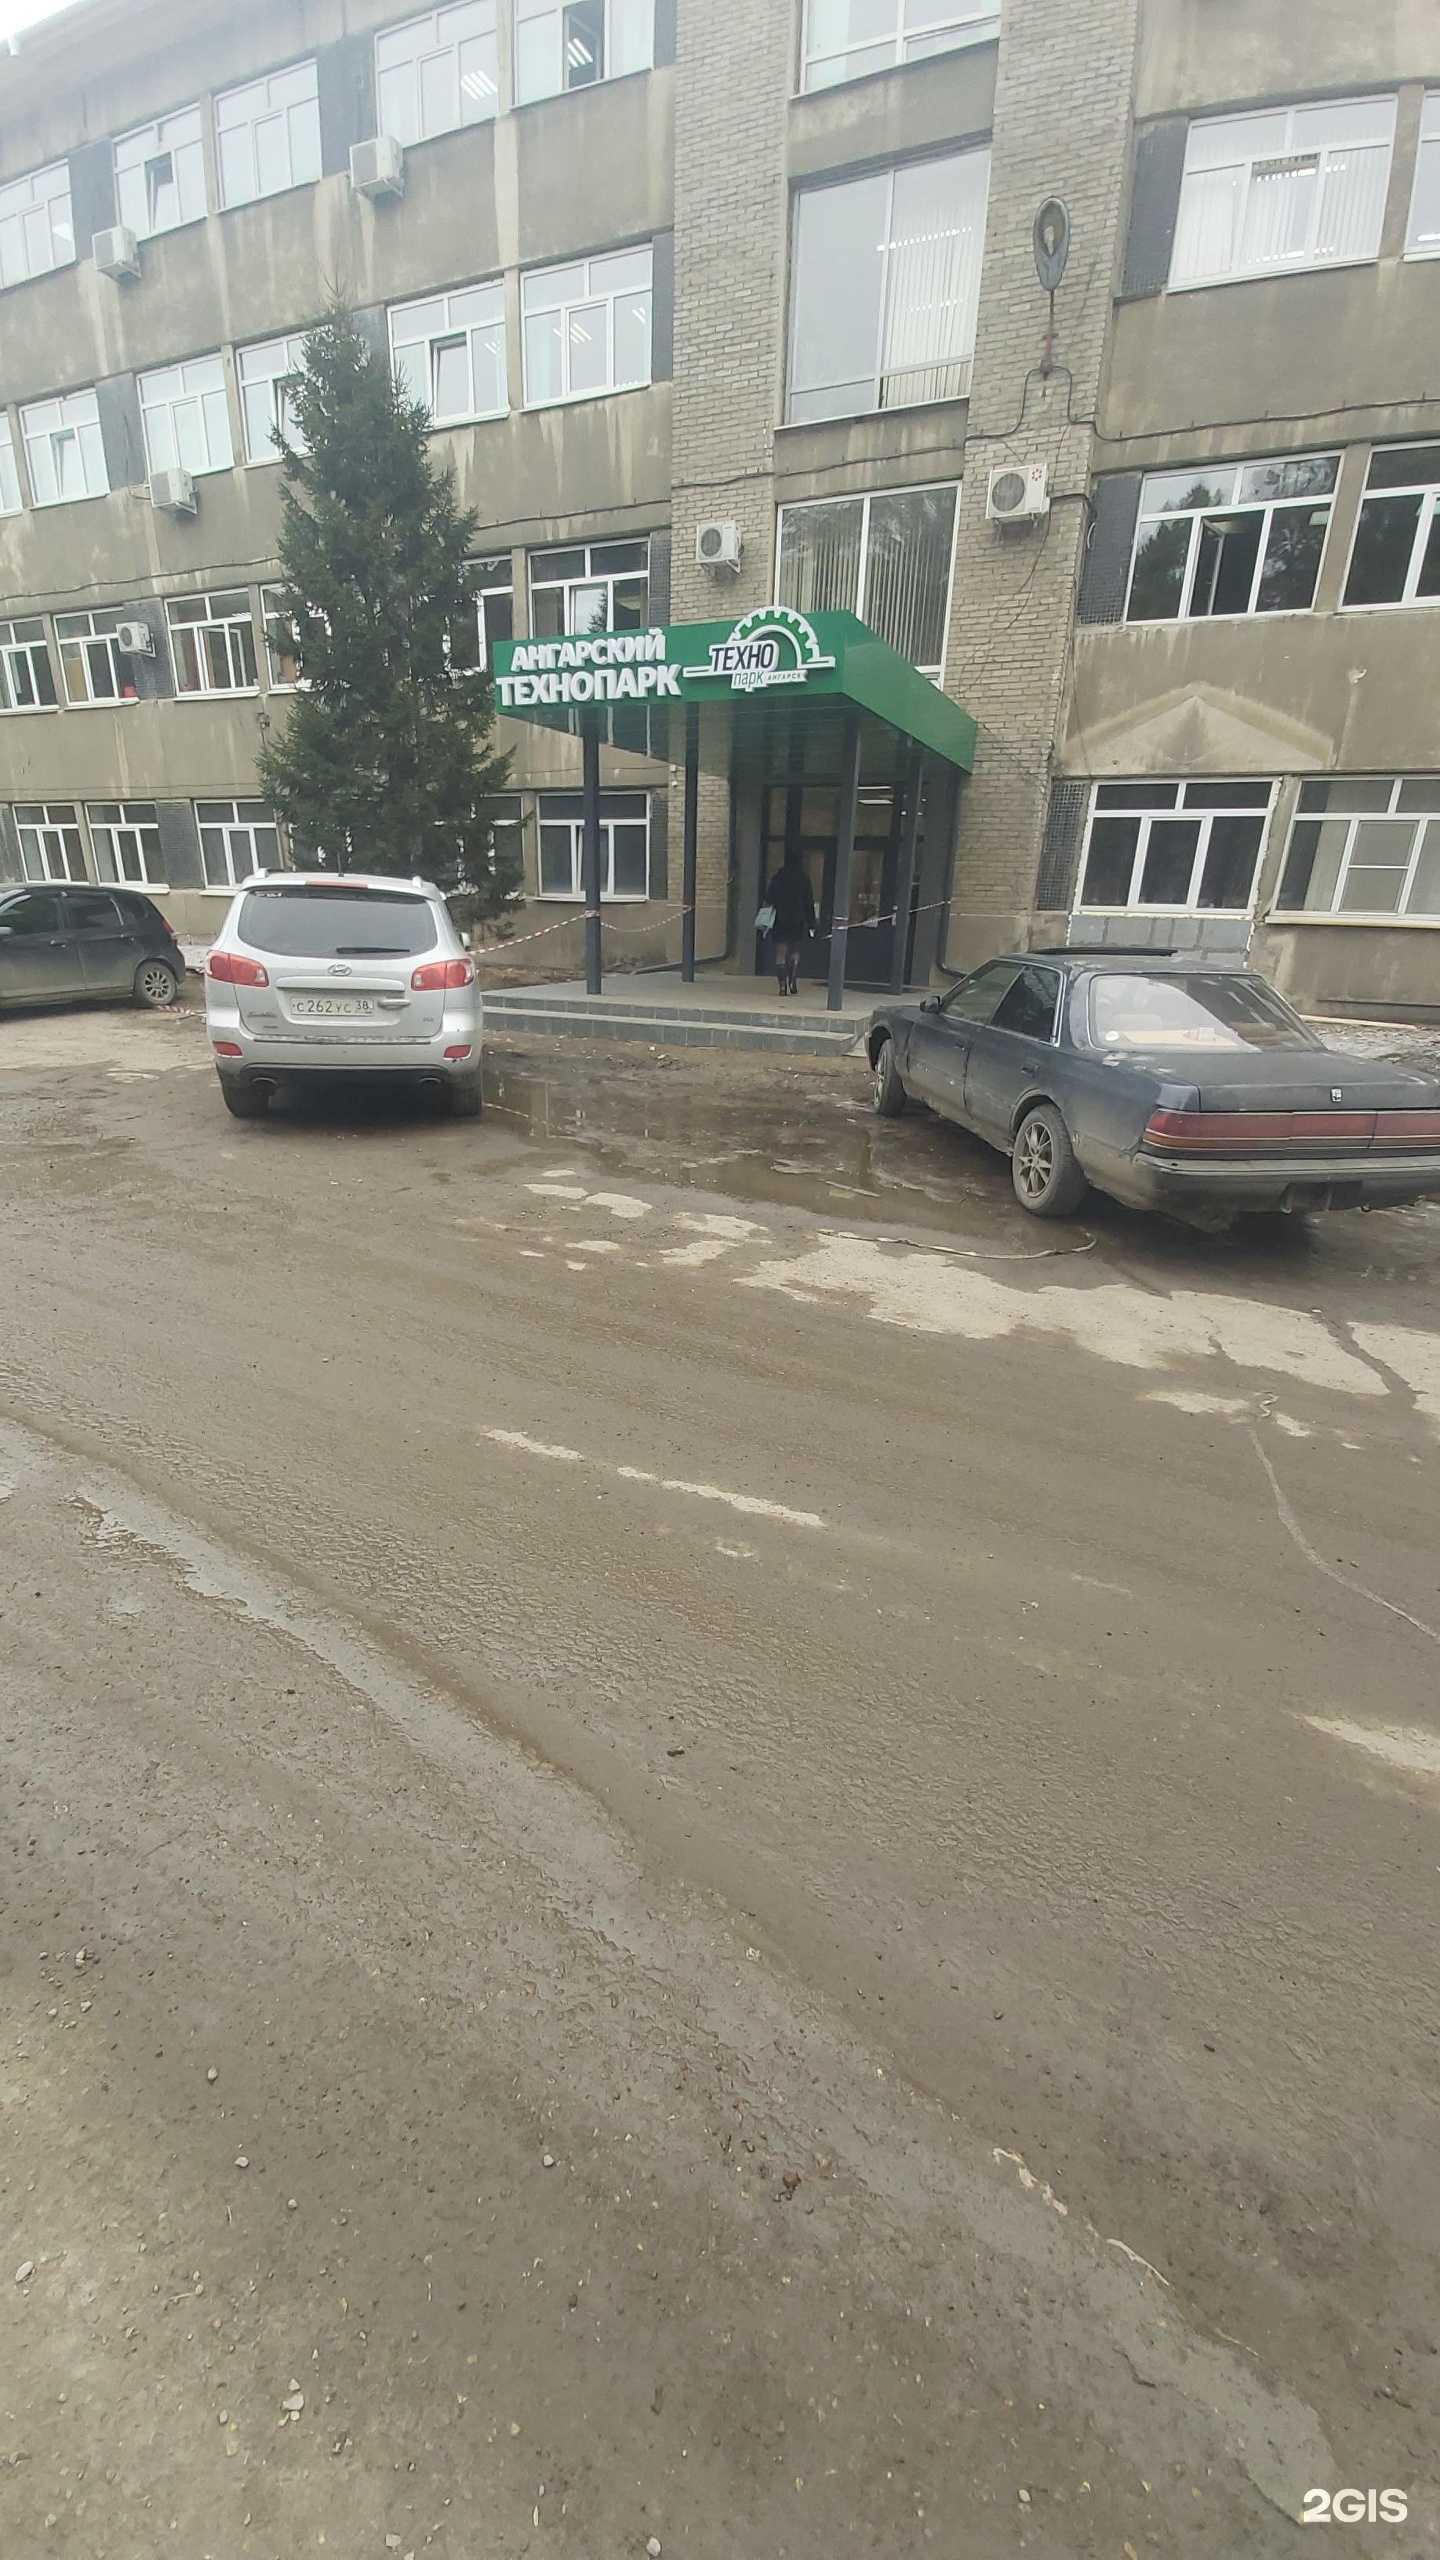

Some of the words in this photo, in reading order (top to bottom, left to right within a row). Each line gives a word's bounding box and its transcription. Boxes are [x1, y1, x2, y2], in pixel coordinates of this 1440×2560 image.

[510, 627, 666, 672] АНГАРСКИЙ
[711, 643, 775, 673] ТЕХНО
[496, 664, 682, 706] ТЕХНОПАРК
[733, 671, 764, 688] парк
